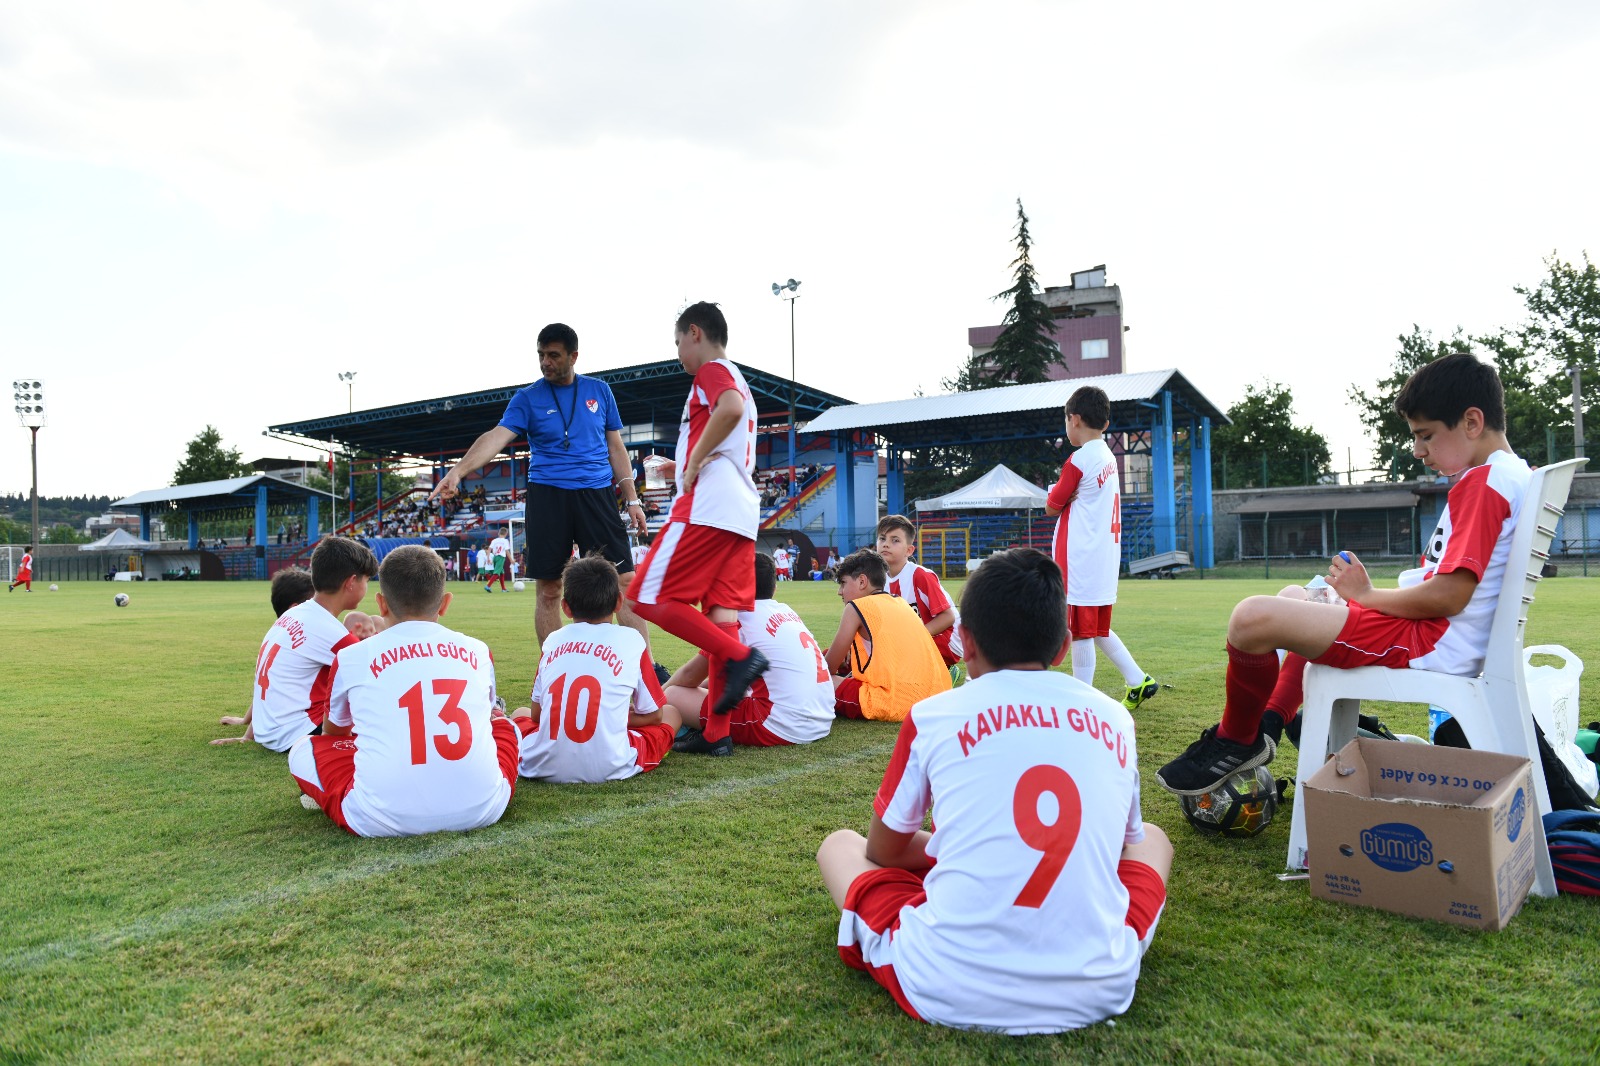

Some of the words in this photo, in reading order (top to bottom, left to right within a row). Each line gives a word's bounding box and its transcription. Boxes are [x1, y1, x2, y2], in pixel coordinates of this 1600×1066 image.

[1111, 493, 1120, 544] 4
[287, 620, 307, 650] GÜCÜ
[799, 631, 829, 684] 2
[255, 640, 281, 701] 14
[369, 642, 434, 680] KAVAKLI
[437, 641, 478, 671] GÜCÜ
[594, 644, 624, 677] GÜCÜ
[398, 678, 473, 766] 13
[548, 672, 602, 744] 10
[957, 704, 1060, 758] KAVAKLI
[1066, 706, 1128, 769] GÜCÜ
[1380, 767, 1415, 784] Adet
[1453, 776, 1469, 788] cc
[1472, 779, 1496, 792] 00
[1013, 764, 1082, 909] 9
[1461, 910, 1482, 920] Adet
